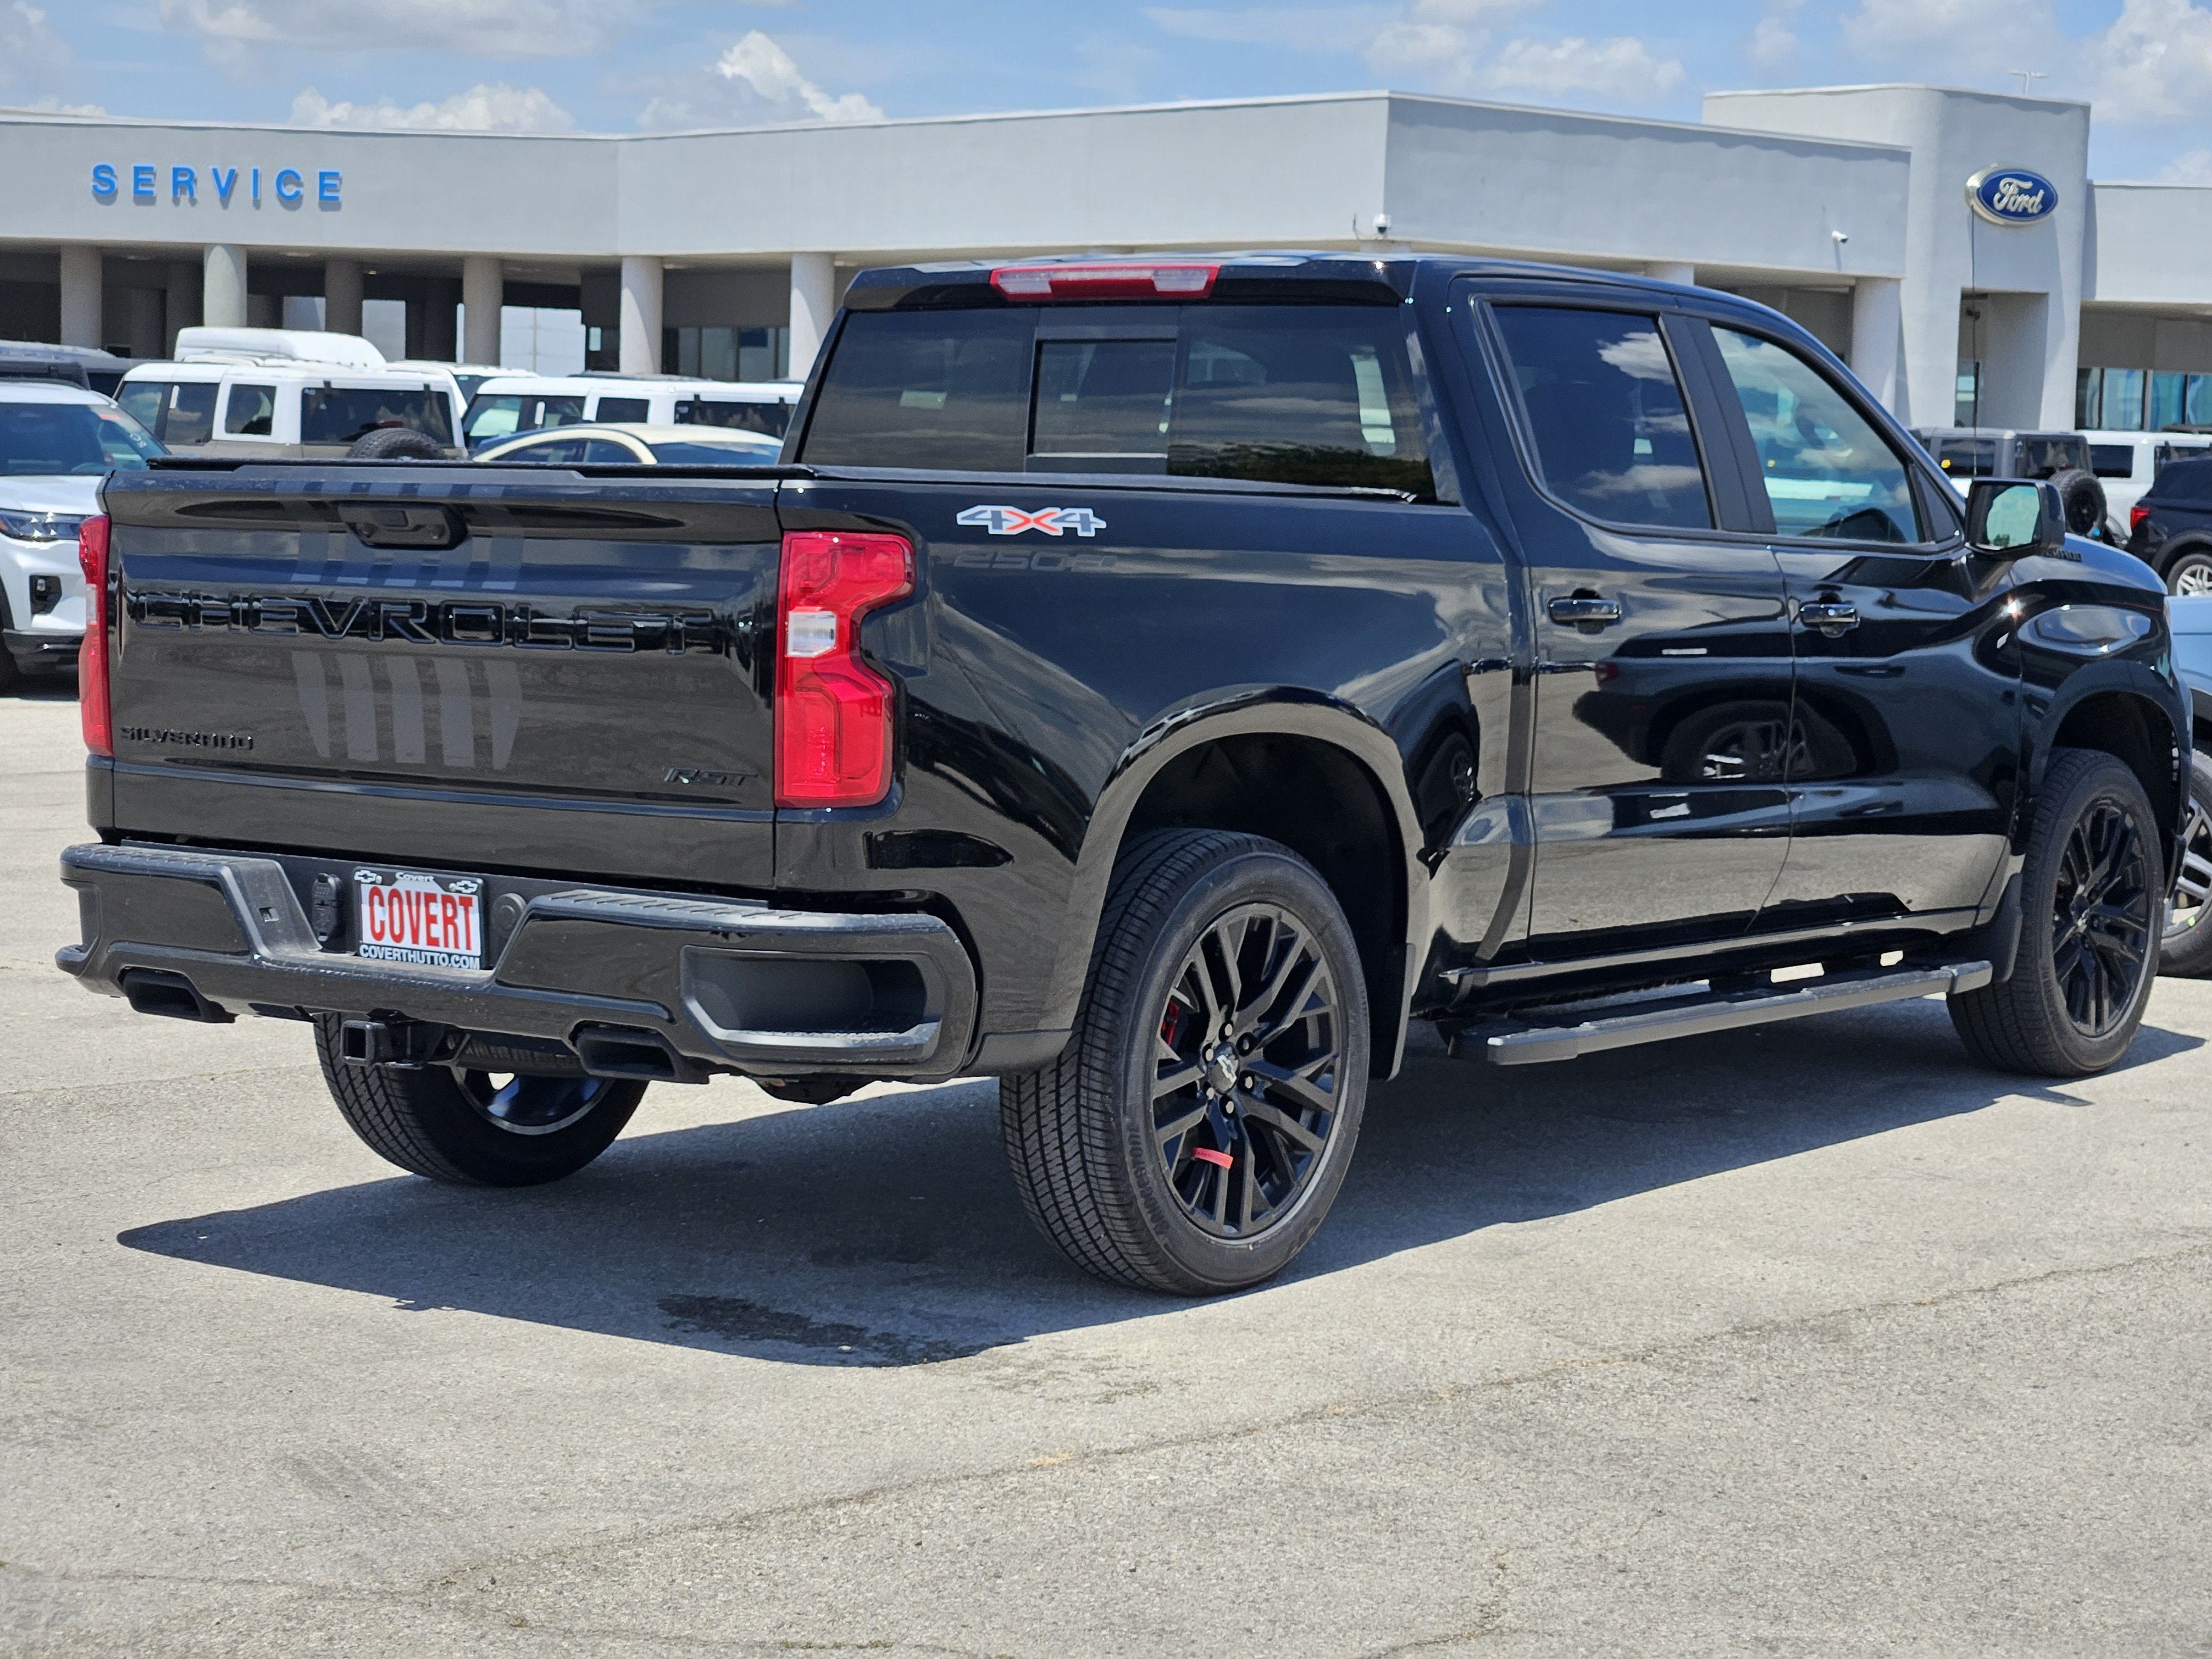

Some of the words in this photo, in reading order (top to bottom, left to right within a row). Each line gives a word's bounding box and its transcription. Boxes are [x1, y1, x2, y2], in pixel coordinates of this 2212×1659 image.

[92, 164, 341, 201] SERVICE
[1994, 178, 2044, 213] Ford
[137, 588, 714, 656] CHEVROLET
[119, 726, 253, 750] SILVERADO
[395, 872, 435, 883] Covert
[369, 886, 473, 951] COVERT
[359, 944, 481, 971] COVERTHUTTO.COM
